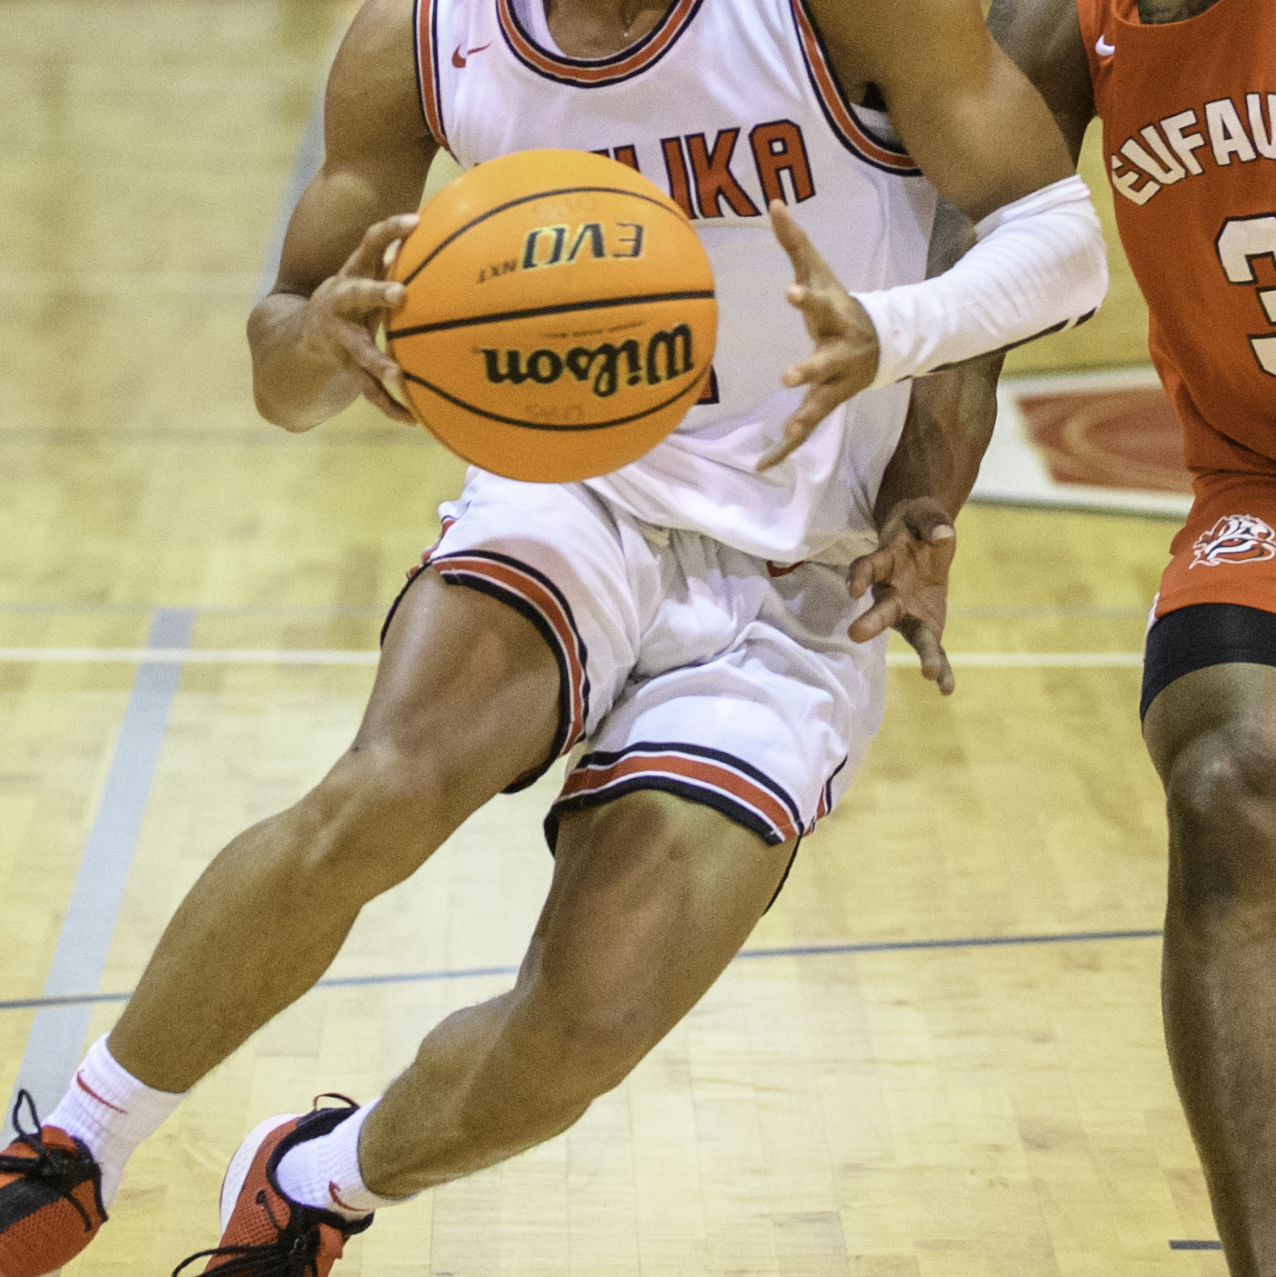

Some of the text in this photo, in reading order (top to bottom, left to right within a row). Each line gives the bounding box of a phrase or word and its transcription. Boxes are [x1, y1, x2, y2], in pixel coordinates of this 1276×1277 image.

[476, 221, 644, 285] EVO NXT
[480, 322, 694, 399] Wilson
